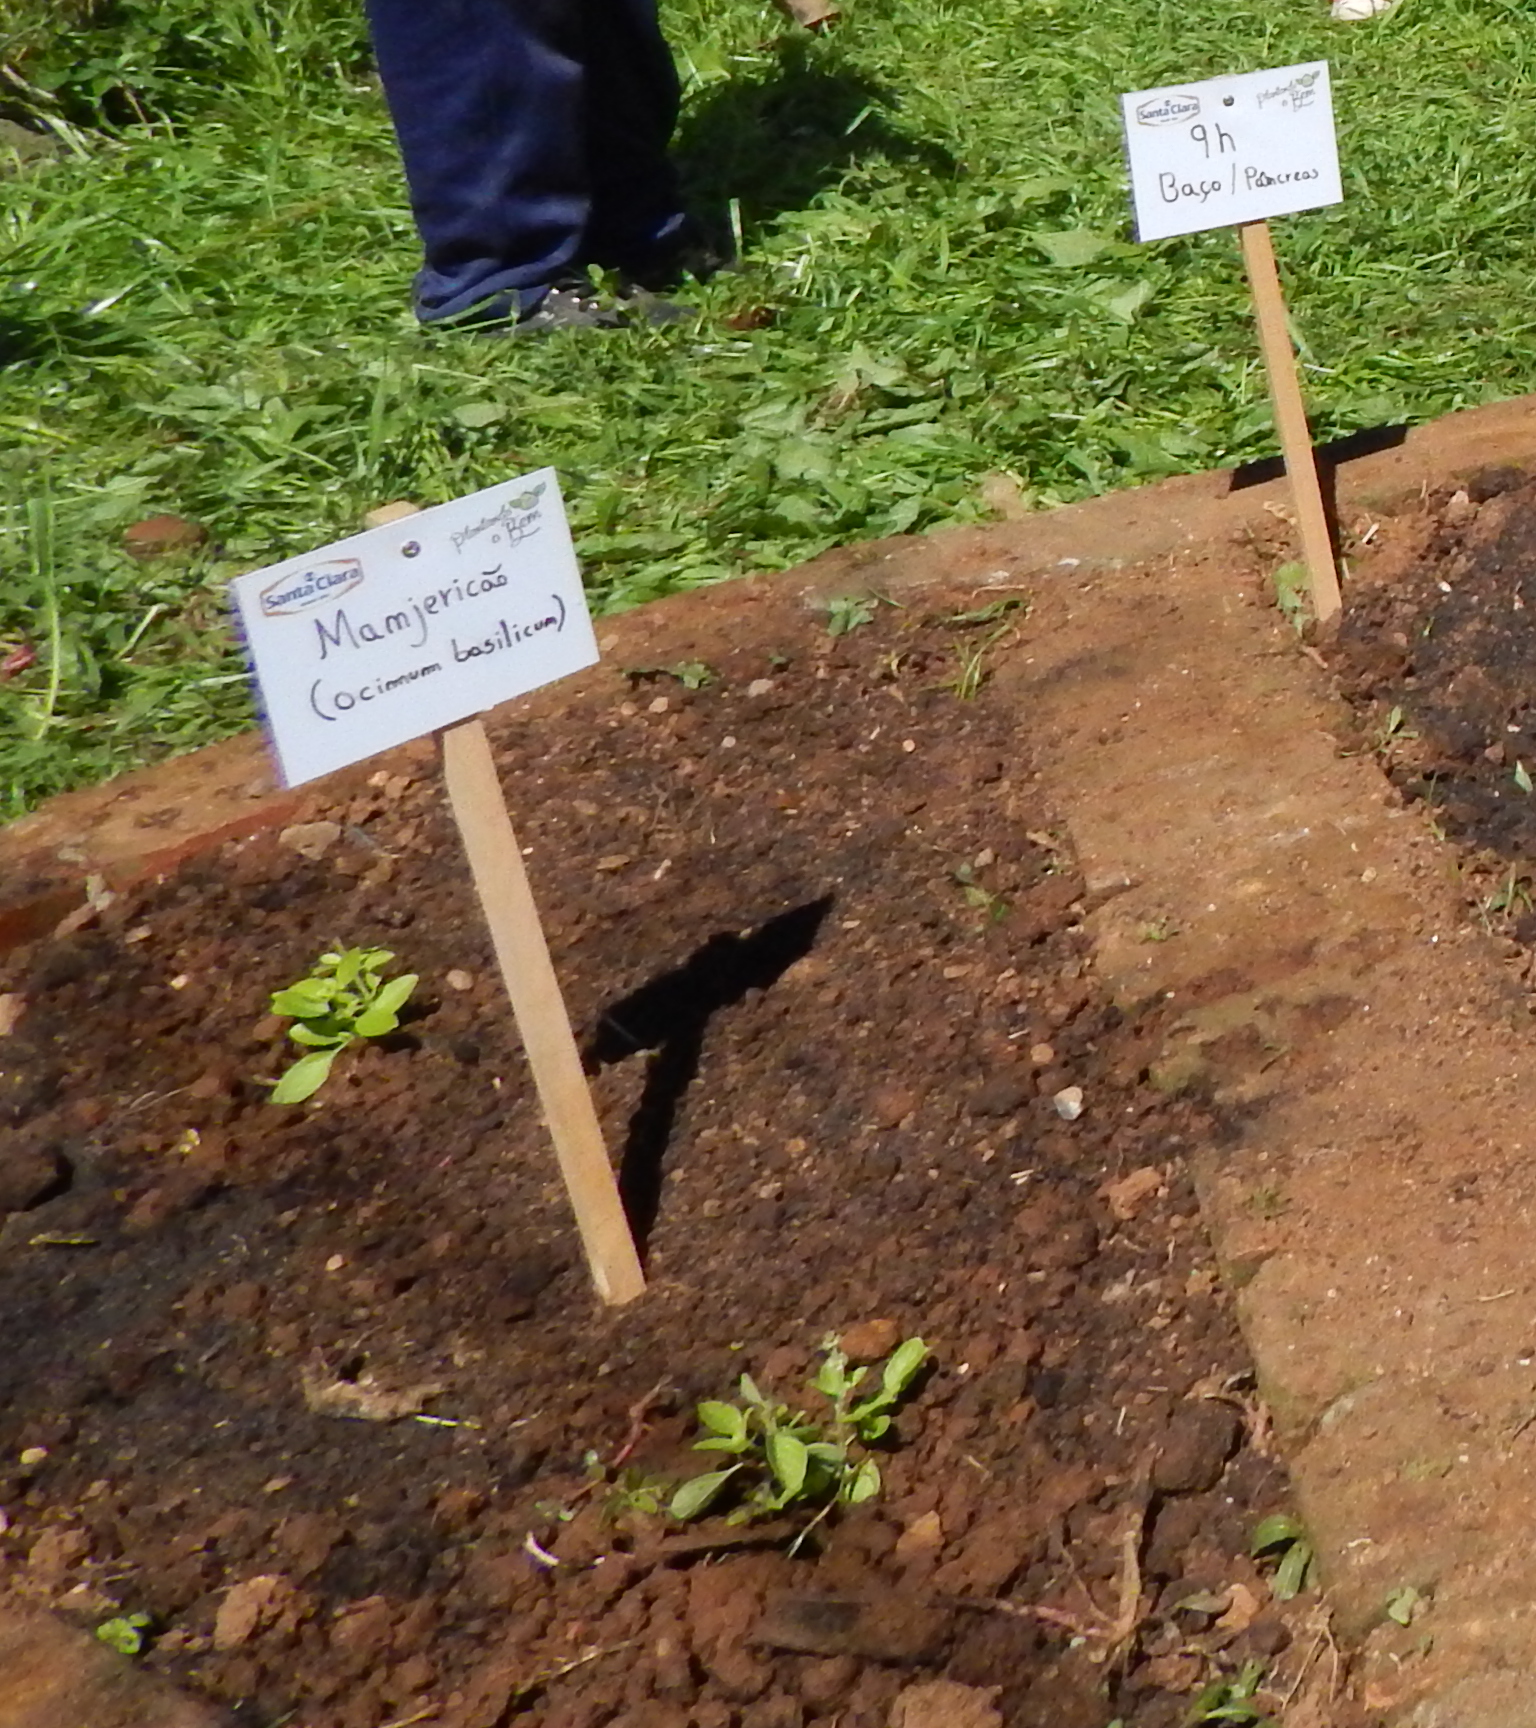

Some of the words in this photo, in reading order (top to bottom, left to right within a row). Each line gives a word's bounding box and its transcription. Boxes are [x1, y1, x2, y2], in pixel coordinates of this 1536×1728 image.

[1190, 123, 1236, 159] 9h
[1159, 172, 1222, 204] Baço
[265, 585, 315, 610] Santa
[315, 568, 359, 591] Clara
[451, 594, 566, 663] basilicum)
